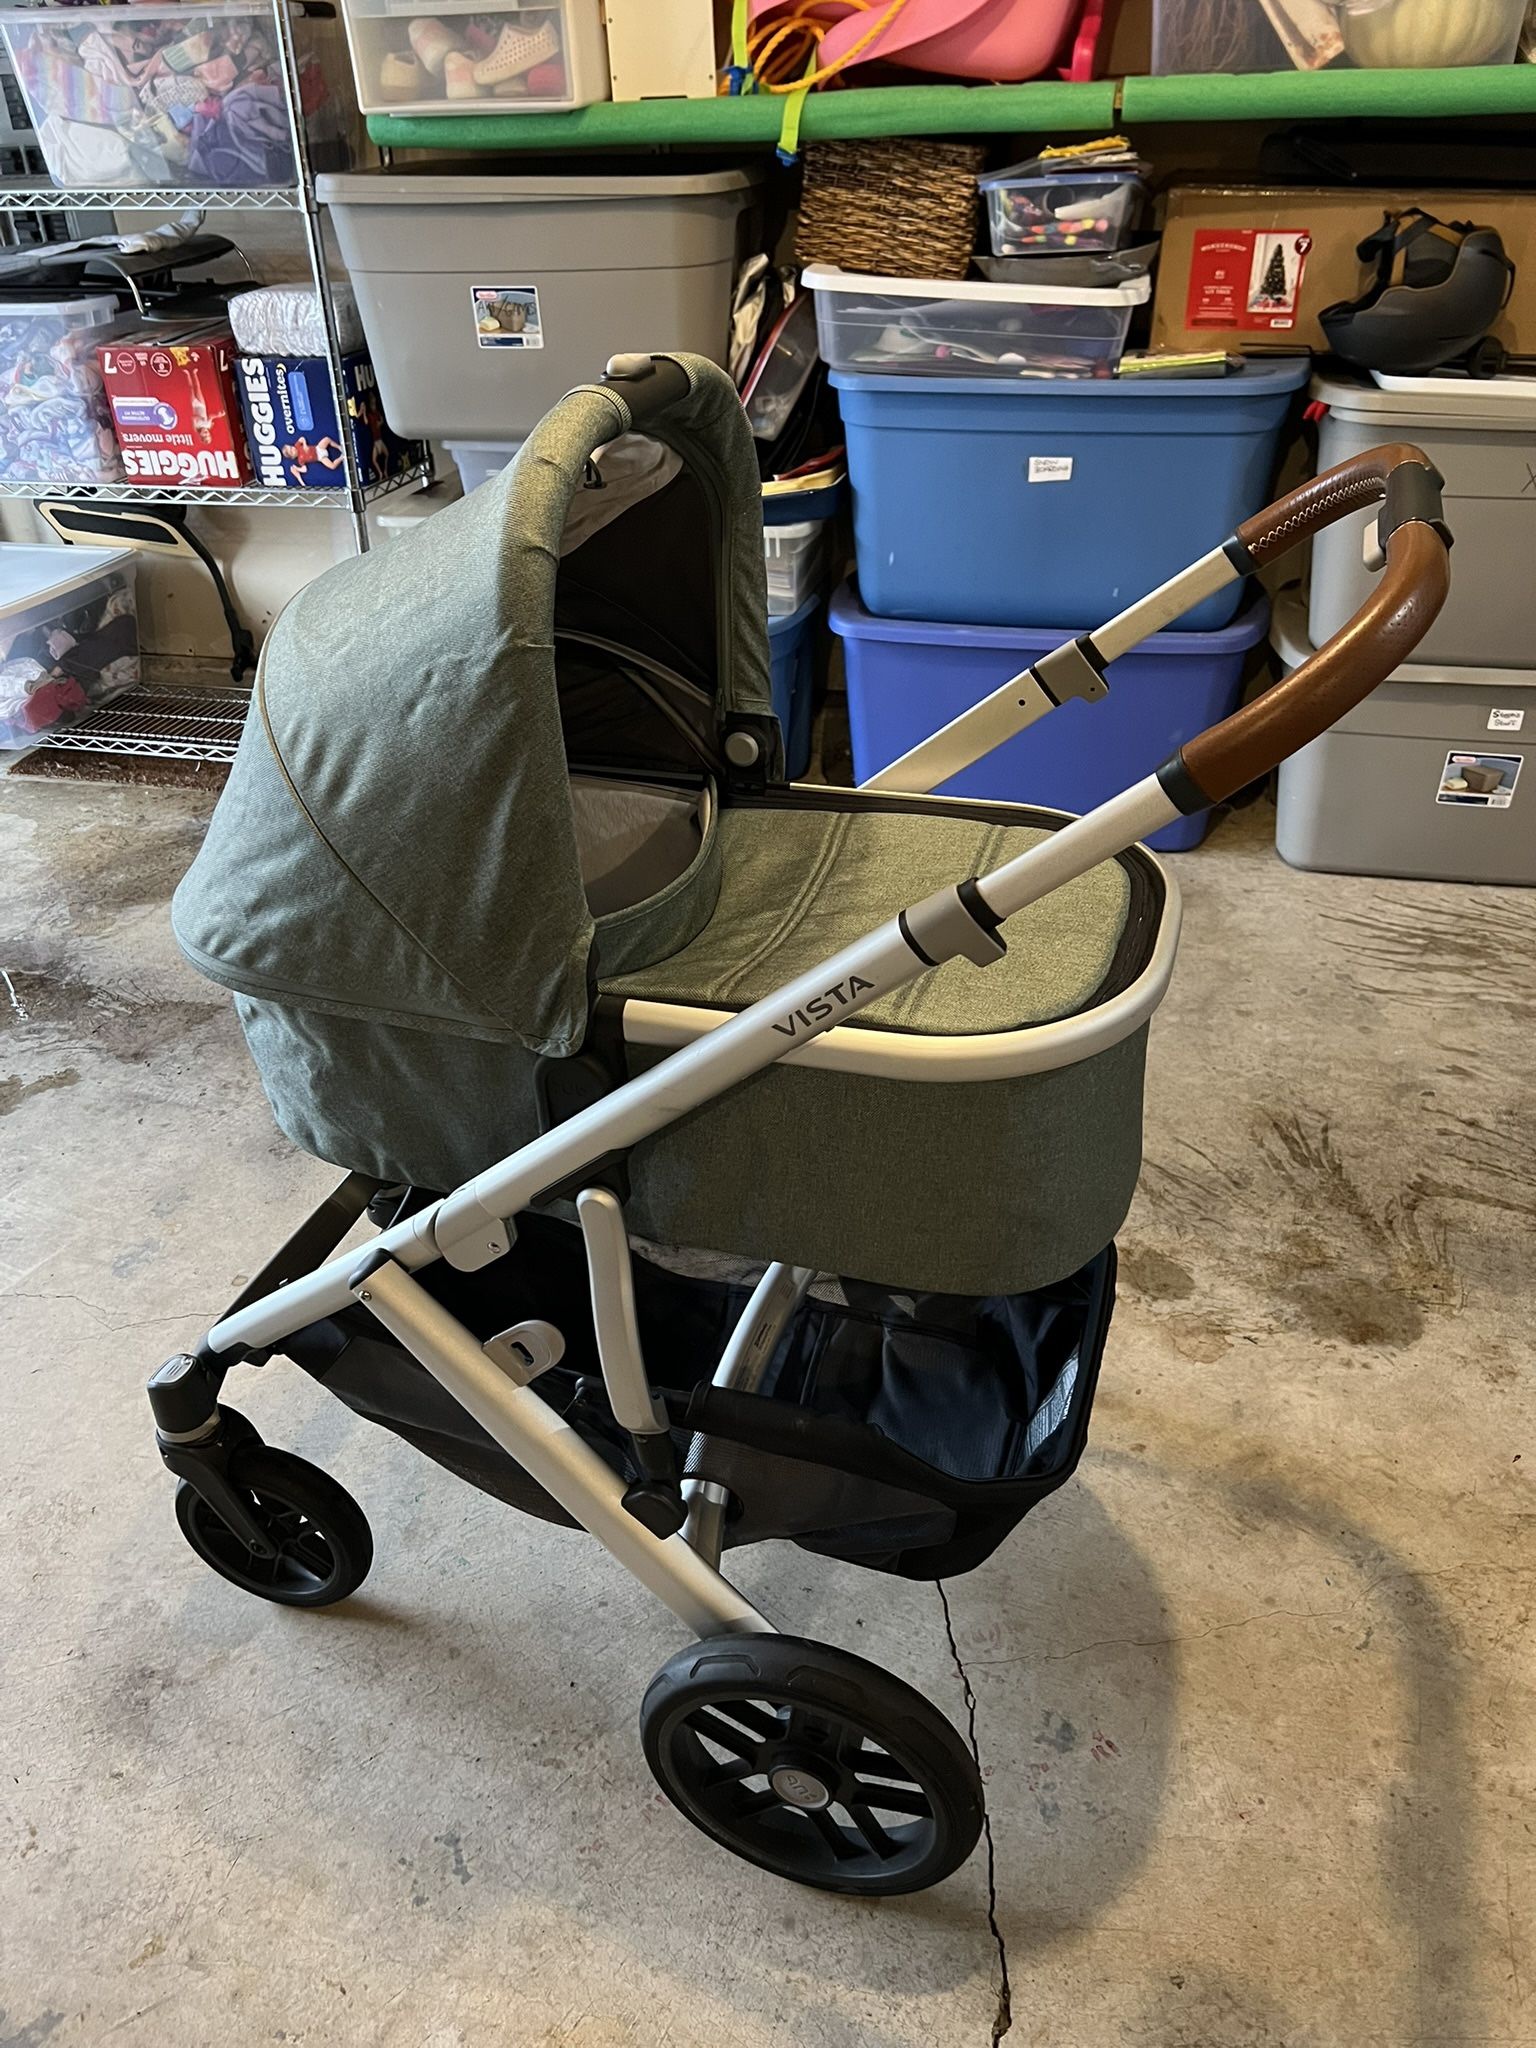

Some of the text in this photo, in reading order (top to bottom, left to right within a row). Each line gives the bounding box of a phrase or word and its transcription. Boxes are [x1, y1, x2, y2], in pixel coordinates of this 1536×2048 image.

[241, 358, 287, 487] HUGGIES
[275, 368, 295, 435] overnites
[121, 450, 240, 479] HUGGIES
[122, 433, 194, 446] little movers
[771, 976, 876, 1037] VISTA
